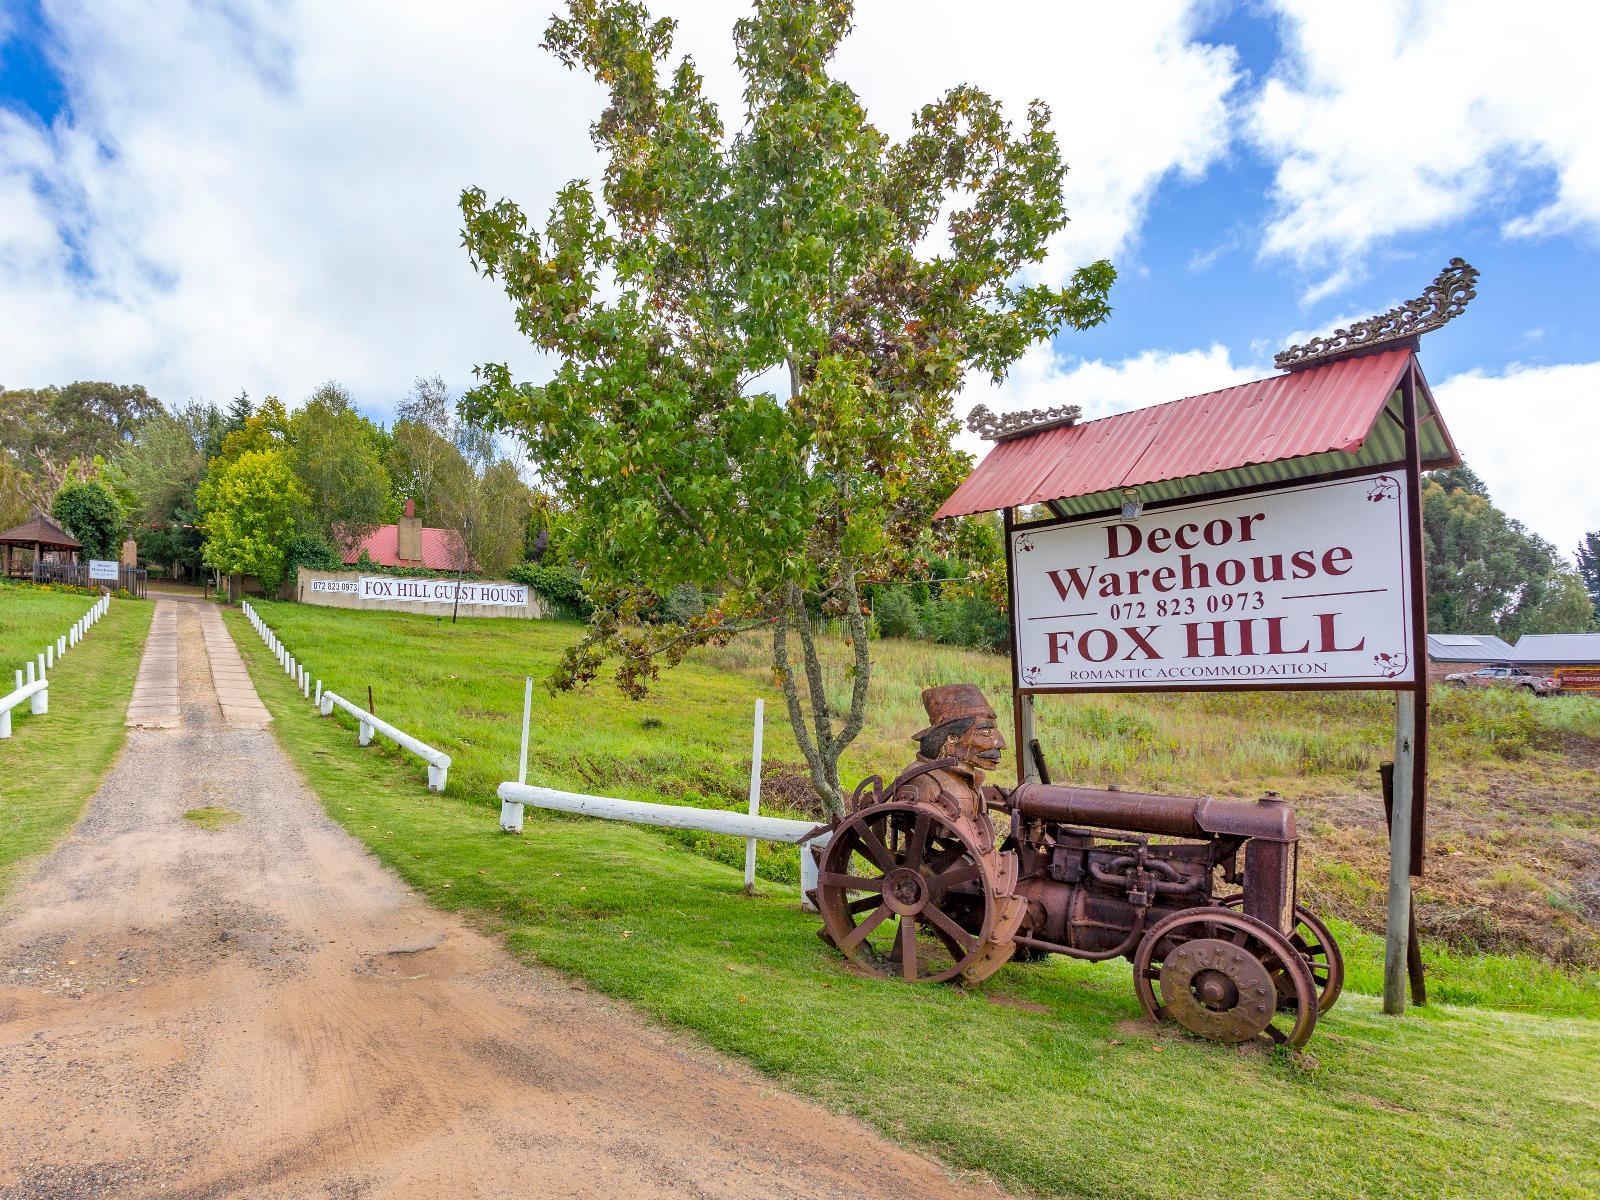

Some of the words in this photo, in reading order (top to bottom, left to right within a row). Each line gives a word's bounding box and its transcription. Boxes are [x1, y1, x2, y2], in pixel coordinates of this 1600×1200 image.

[1102, 512, 1266, 560] Decor
[313, 581, 326, 590] 072
[327, 582, 340, 591] 823
[341, 583, 358, 592] 0973
[1045, 546, 1353, 602] Warehouse
[365, 581, 393, 596] FOX
[397, 582, 431, 598] HILL
[434, 585, 477, 601] GUEST
[481, 587, 524, 603] HOUSE
[1110, 602, 1147, 621] 072
[1156, 597, 1196, 617] 823
[1206, 590, 1265, 614] 0973
[1044, 624, 1165, 664] FOX
[1180, 612, 1366, 659] HILL
[1070, 667, 1152, 680] ROMANTIC
[1156, 662, 1328, 678] ACCOMMODATION
